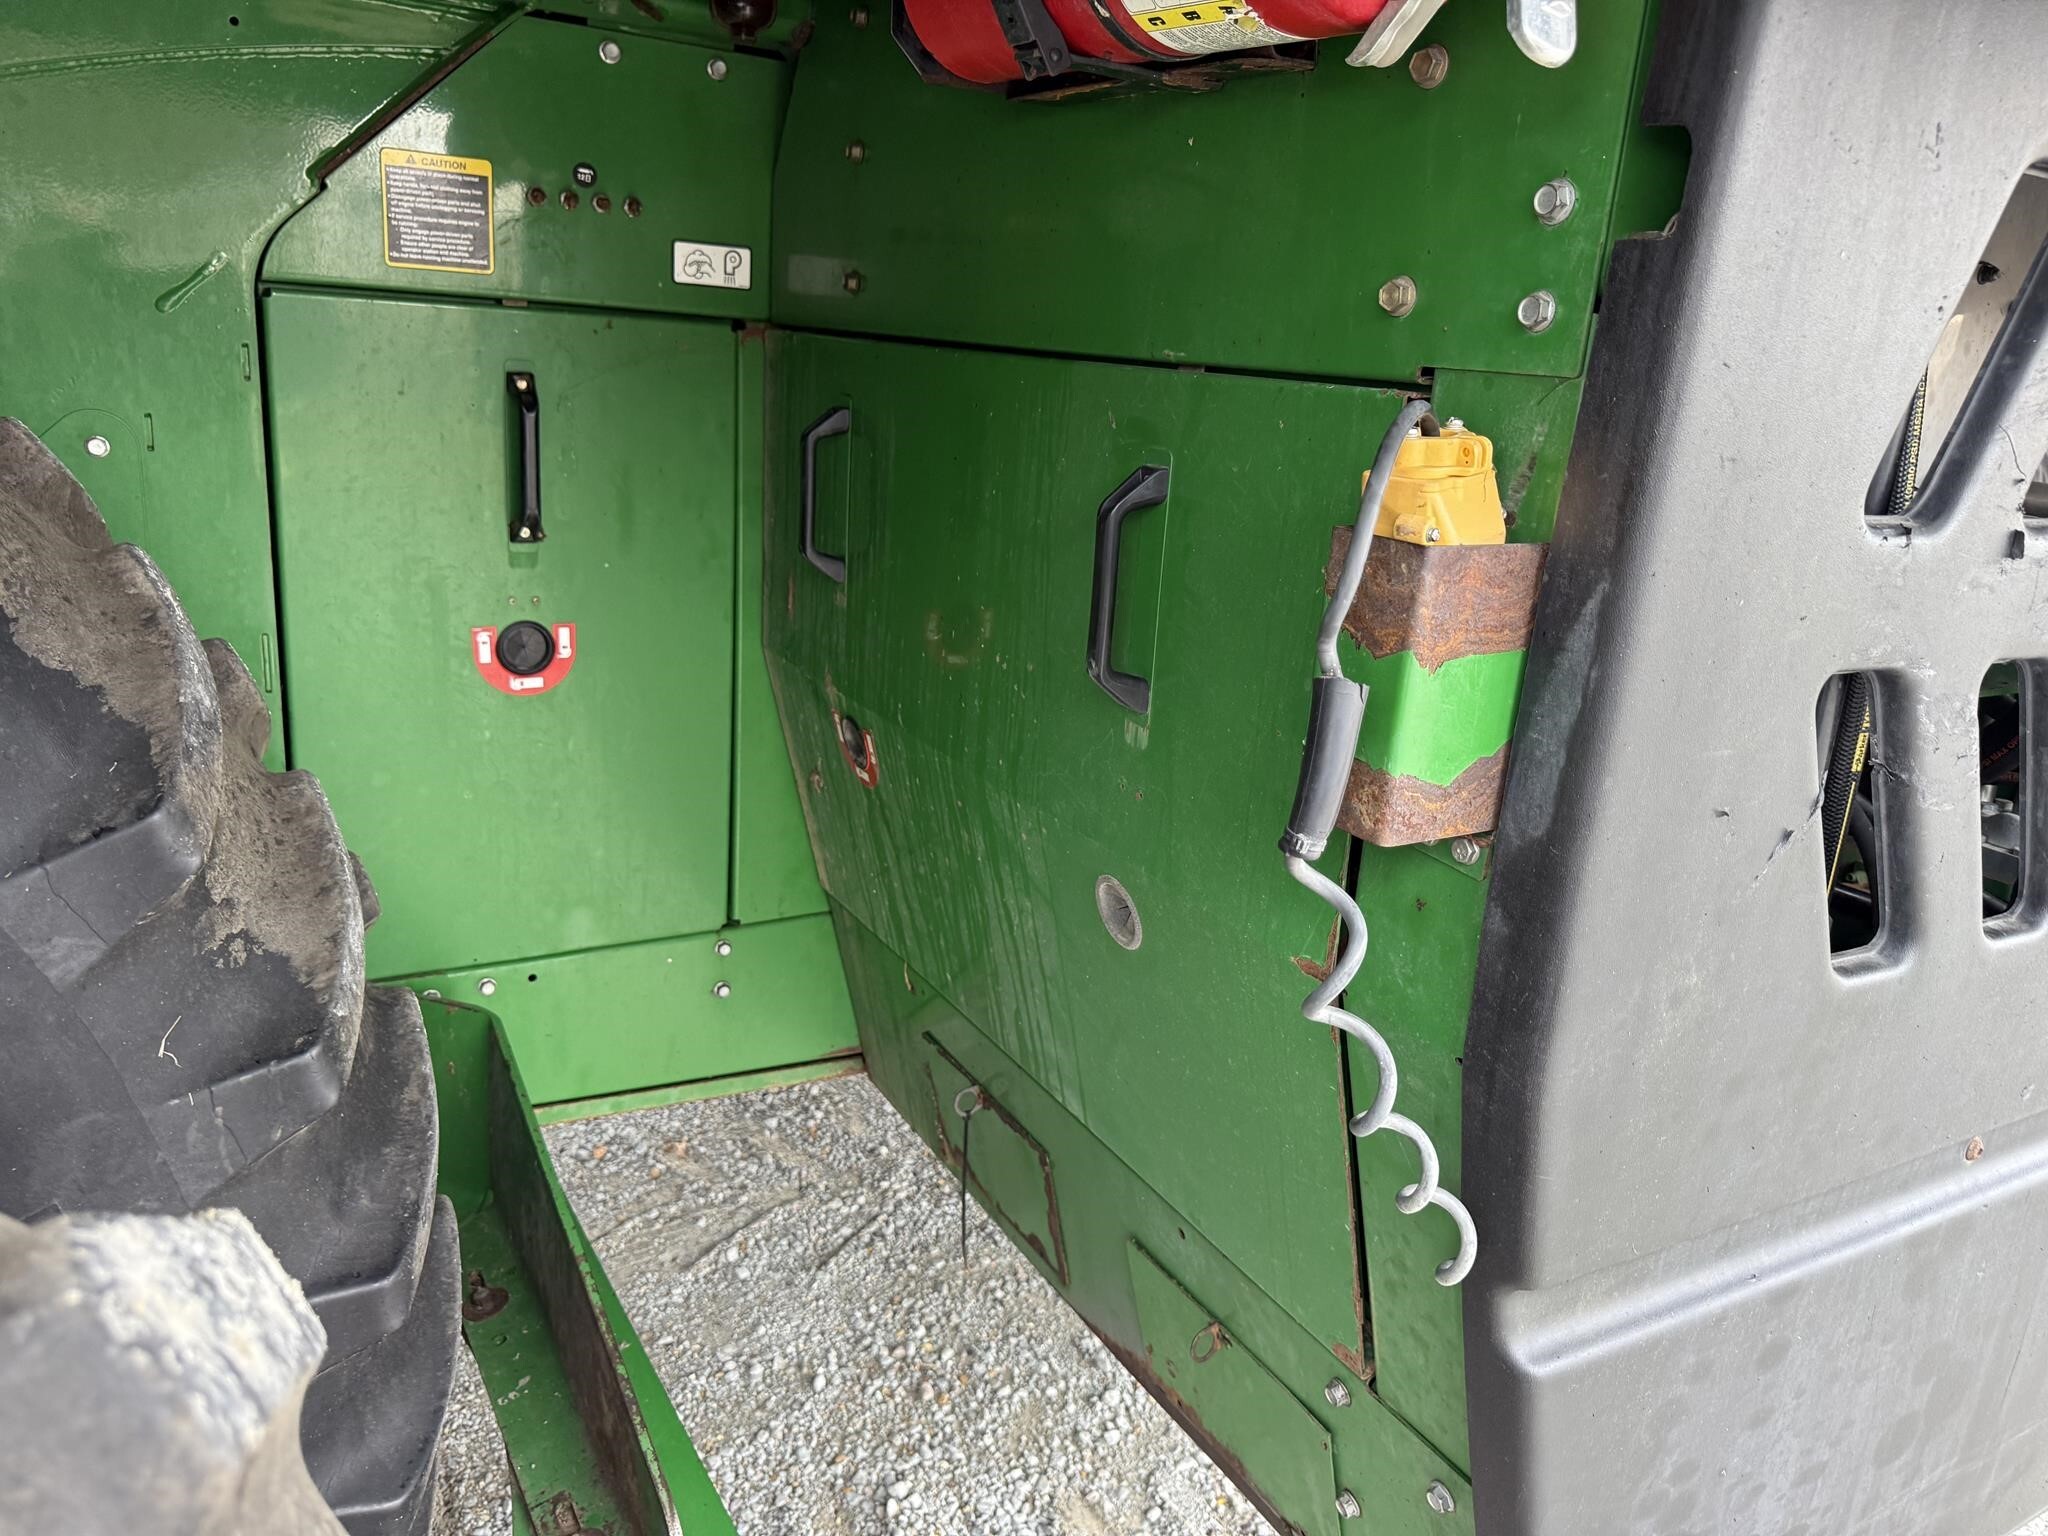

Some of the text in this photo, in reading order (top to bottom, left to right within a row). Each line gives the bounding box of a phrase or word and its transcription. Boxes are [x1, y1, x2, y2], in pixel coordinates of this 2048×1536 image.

[1148, 16, 1166, 26] C
[1182, 11, 1201, 21] B
[421, 157, 467, 171] CAUTION
